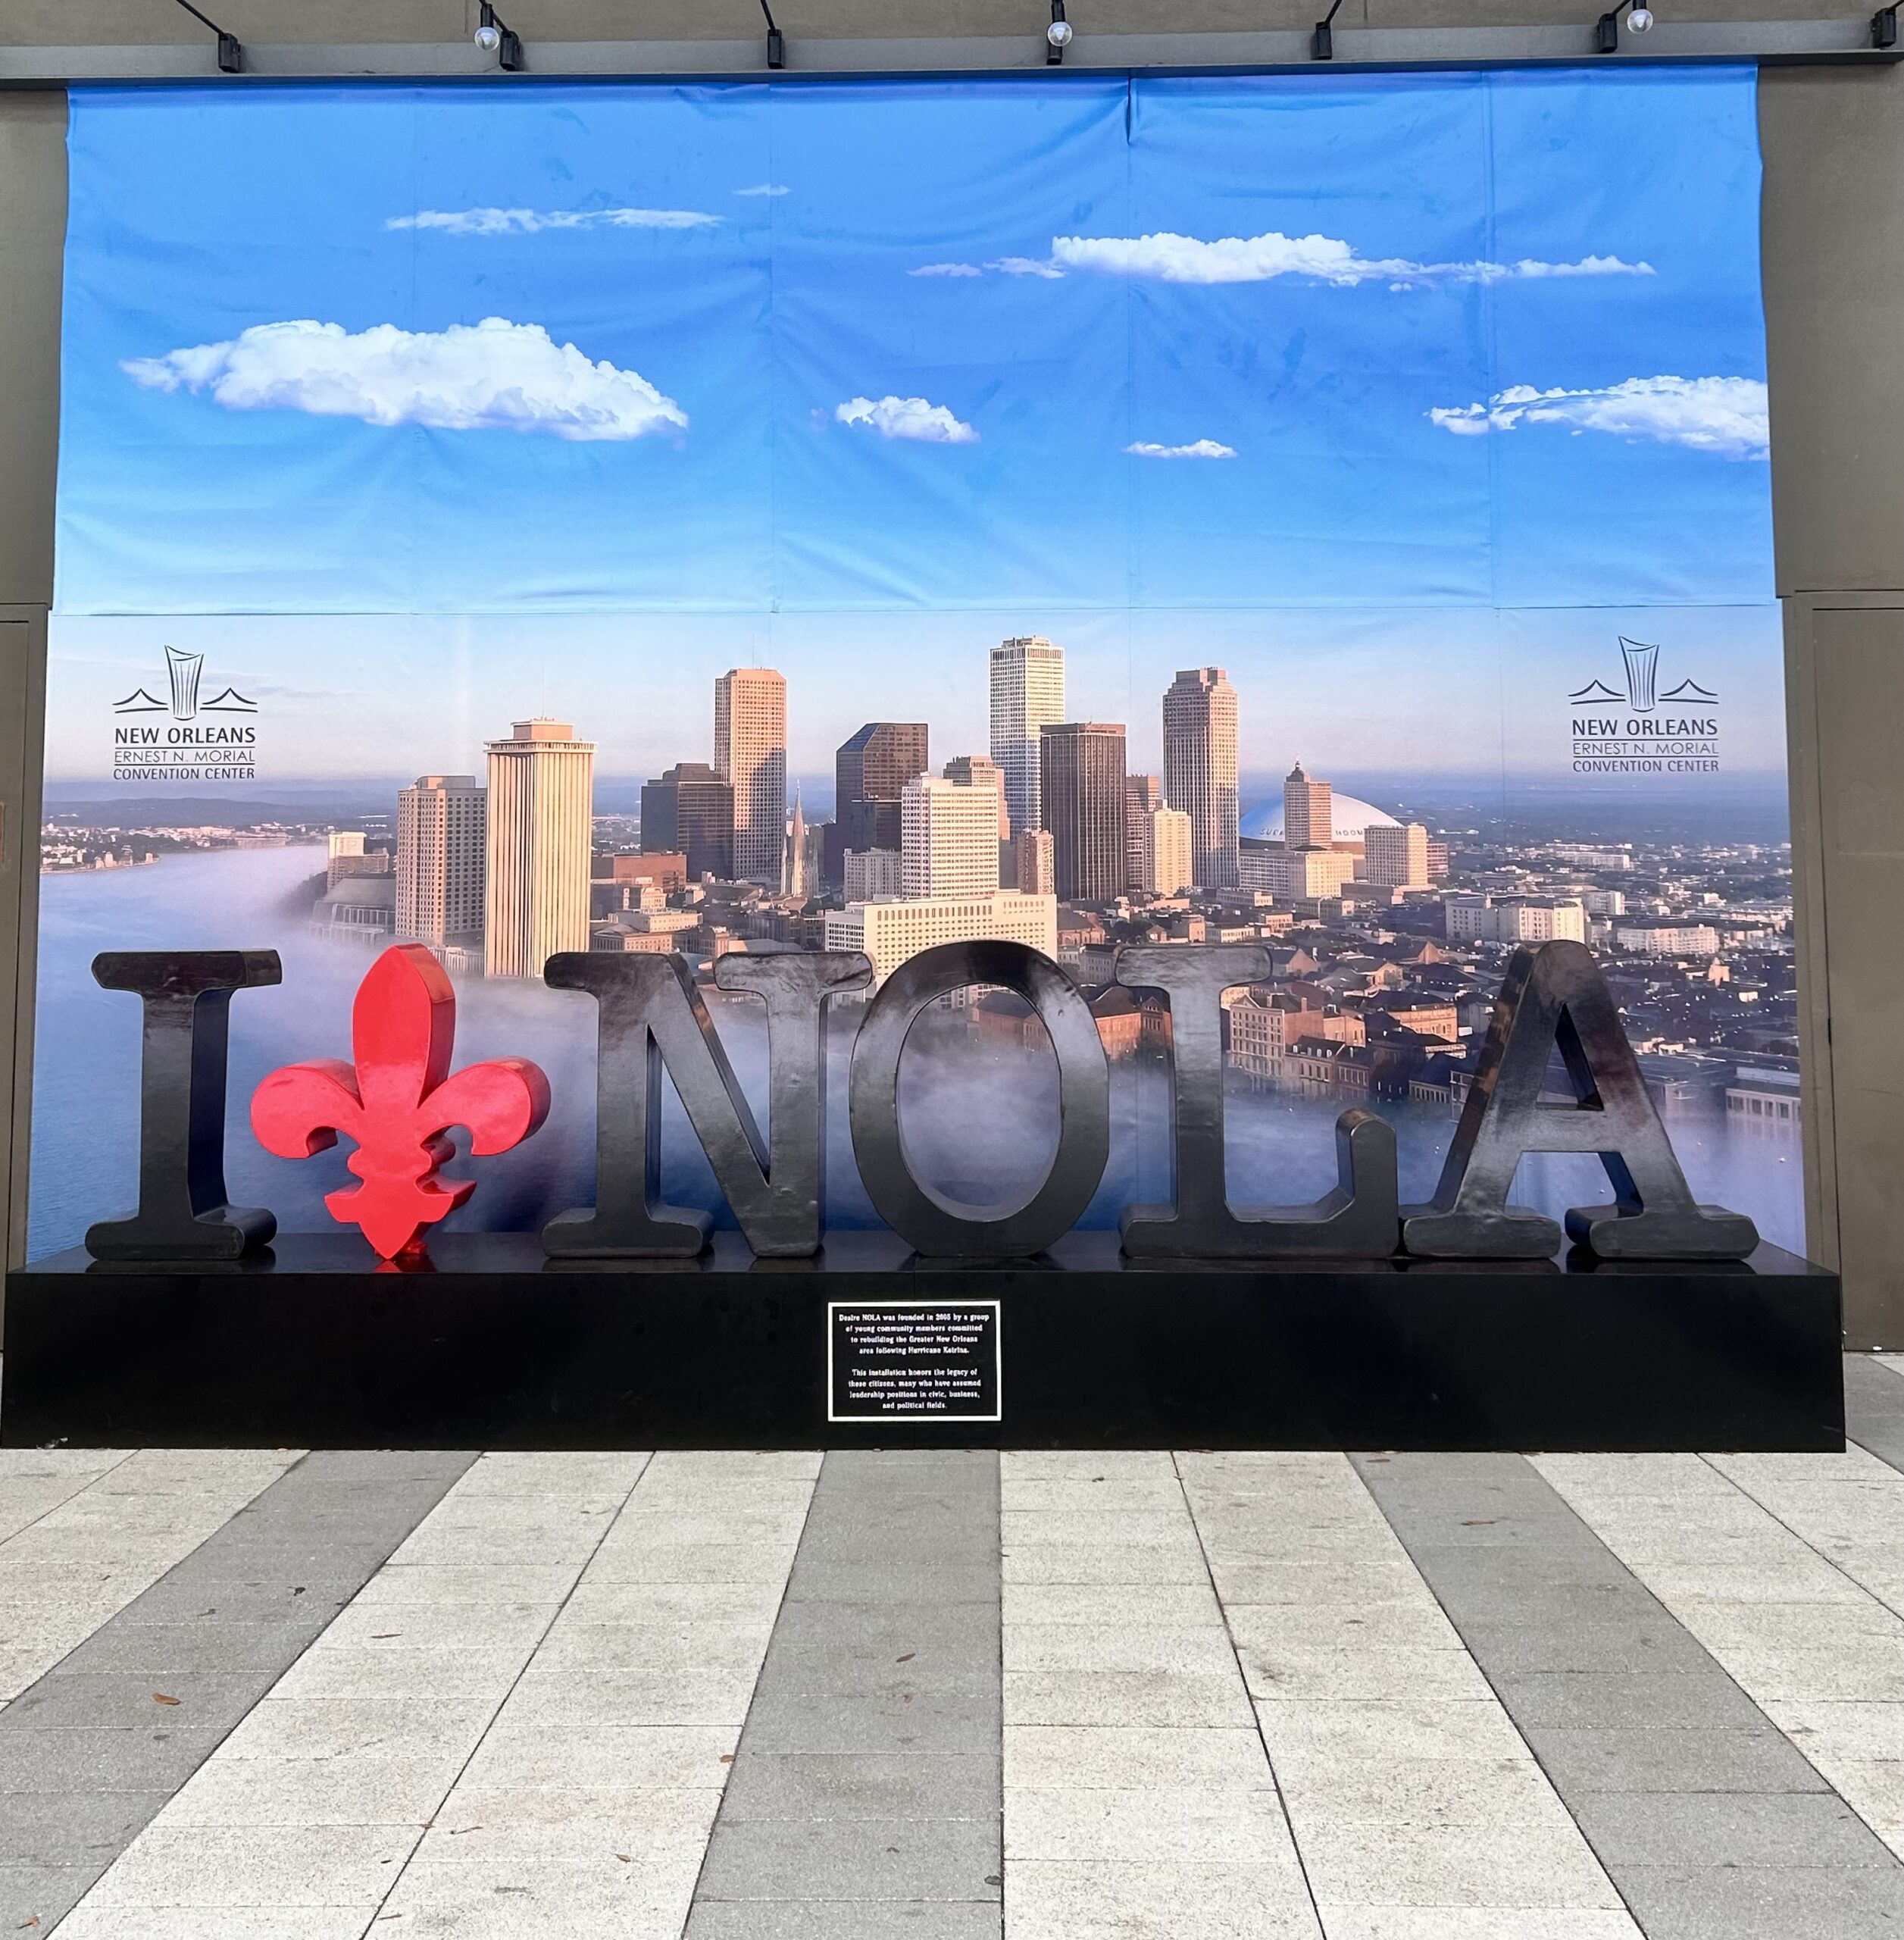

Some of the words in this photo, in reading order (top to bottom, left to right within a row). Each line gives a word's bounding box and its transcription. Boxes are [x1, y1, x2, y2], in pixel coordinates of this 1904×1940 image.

[1572, 719, 1618, 736] NEW
[1626, 718, 1718, 736] ORLEANS
[115, 728, 160, 744] NEW
[167, 727, 256, 743] ORLEANS
[1572, 742, 1628, 755] ERNEST
[1634, 743, 1651, 755] N.
[1655, 742, 1720, 755] MORIAL
[114, 750, 168, 763] ERNEST
[173, 750, 189, 762] N.
[194, 749, 255, 762] MORIAL
[1572, 760, 1662, 773] CONVENTION
[1667, 760, 1720, 772] CENTER
[113, 768, 200, 780] CONVENTION
[205, 768, 255, 779] CENTER
[85, 950, 283, 1260] I
[542, 939, 1759, 1259] NOLA
[861, 1313, 881, 1322] NOLA
[897, 1313, 925, 1322] founded
[935, 1313, 952, 1321] 2005
[952, 1313, 962, 1322] by
[970, 1314, 990, 1322] group
[854, 1325, 876, 1334] young
[877, 1325, 914, 1334] community
[915, 1324, 946, 1332] members
[947, 1324, 983, 1332] committed
[859, 1335, 894, 1344] rebuilding
[908, 1335, 934, 1343] Greater
[936, 1335, 951, 1343] New
[952, 1335, 978, 1343] Orleans
[876, 1347, 907, 1356] following
[908, 1346, 942, 1354] Hurricane
[908, 1368, 932, 1376] honors
[933, 1368, 946, 1376] the
[946, 1368, 969, 1377] legacy
[970, 1368, 977, 1376] of
[848, 1379, 867, 1388] these
[849, 1391, 885, 1400] leadership
[886, 1391, 918, 1400] positions
[882, 1401, 895, 1410] and
[896, 1401, 925, 1410] political
